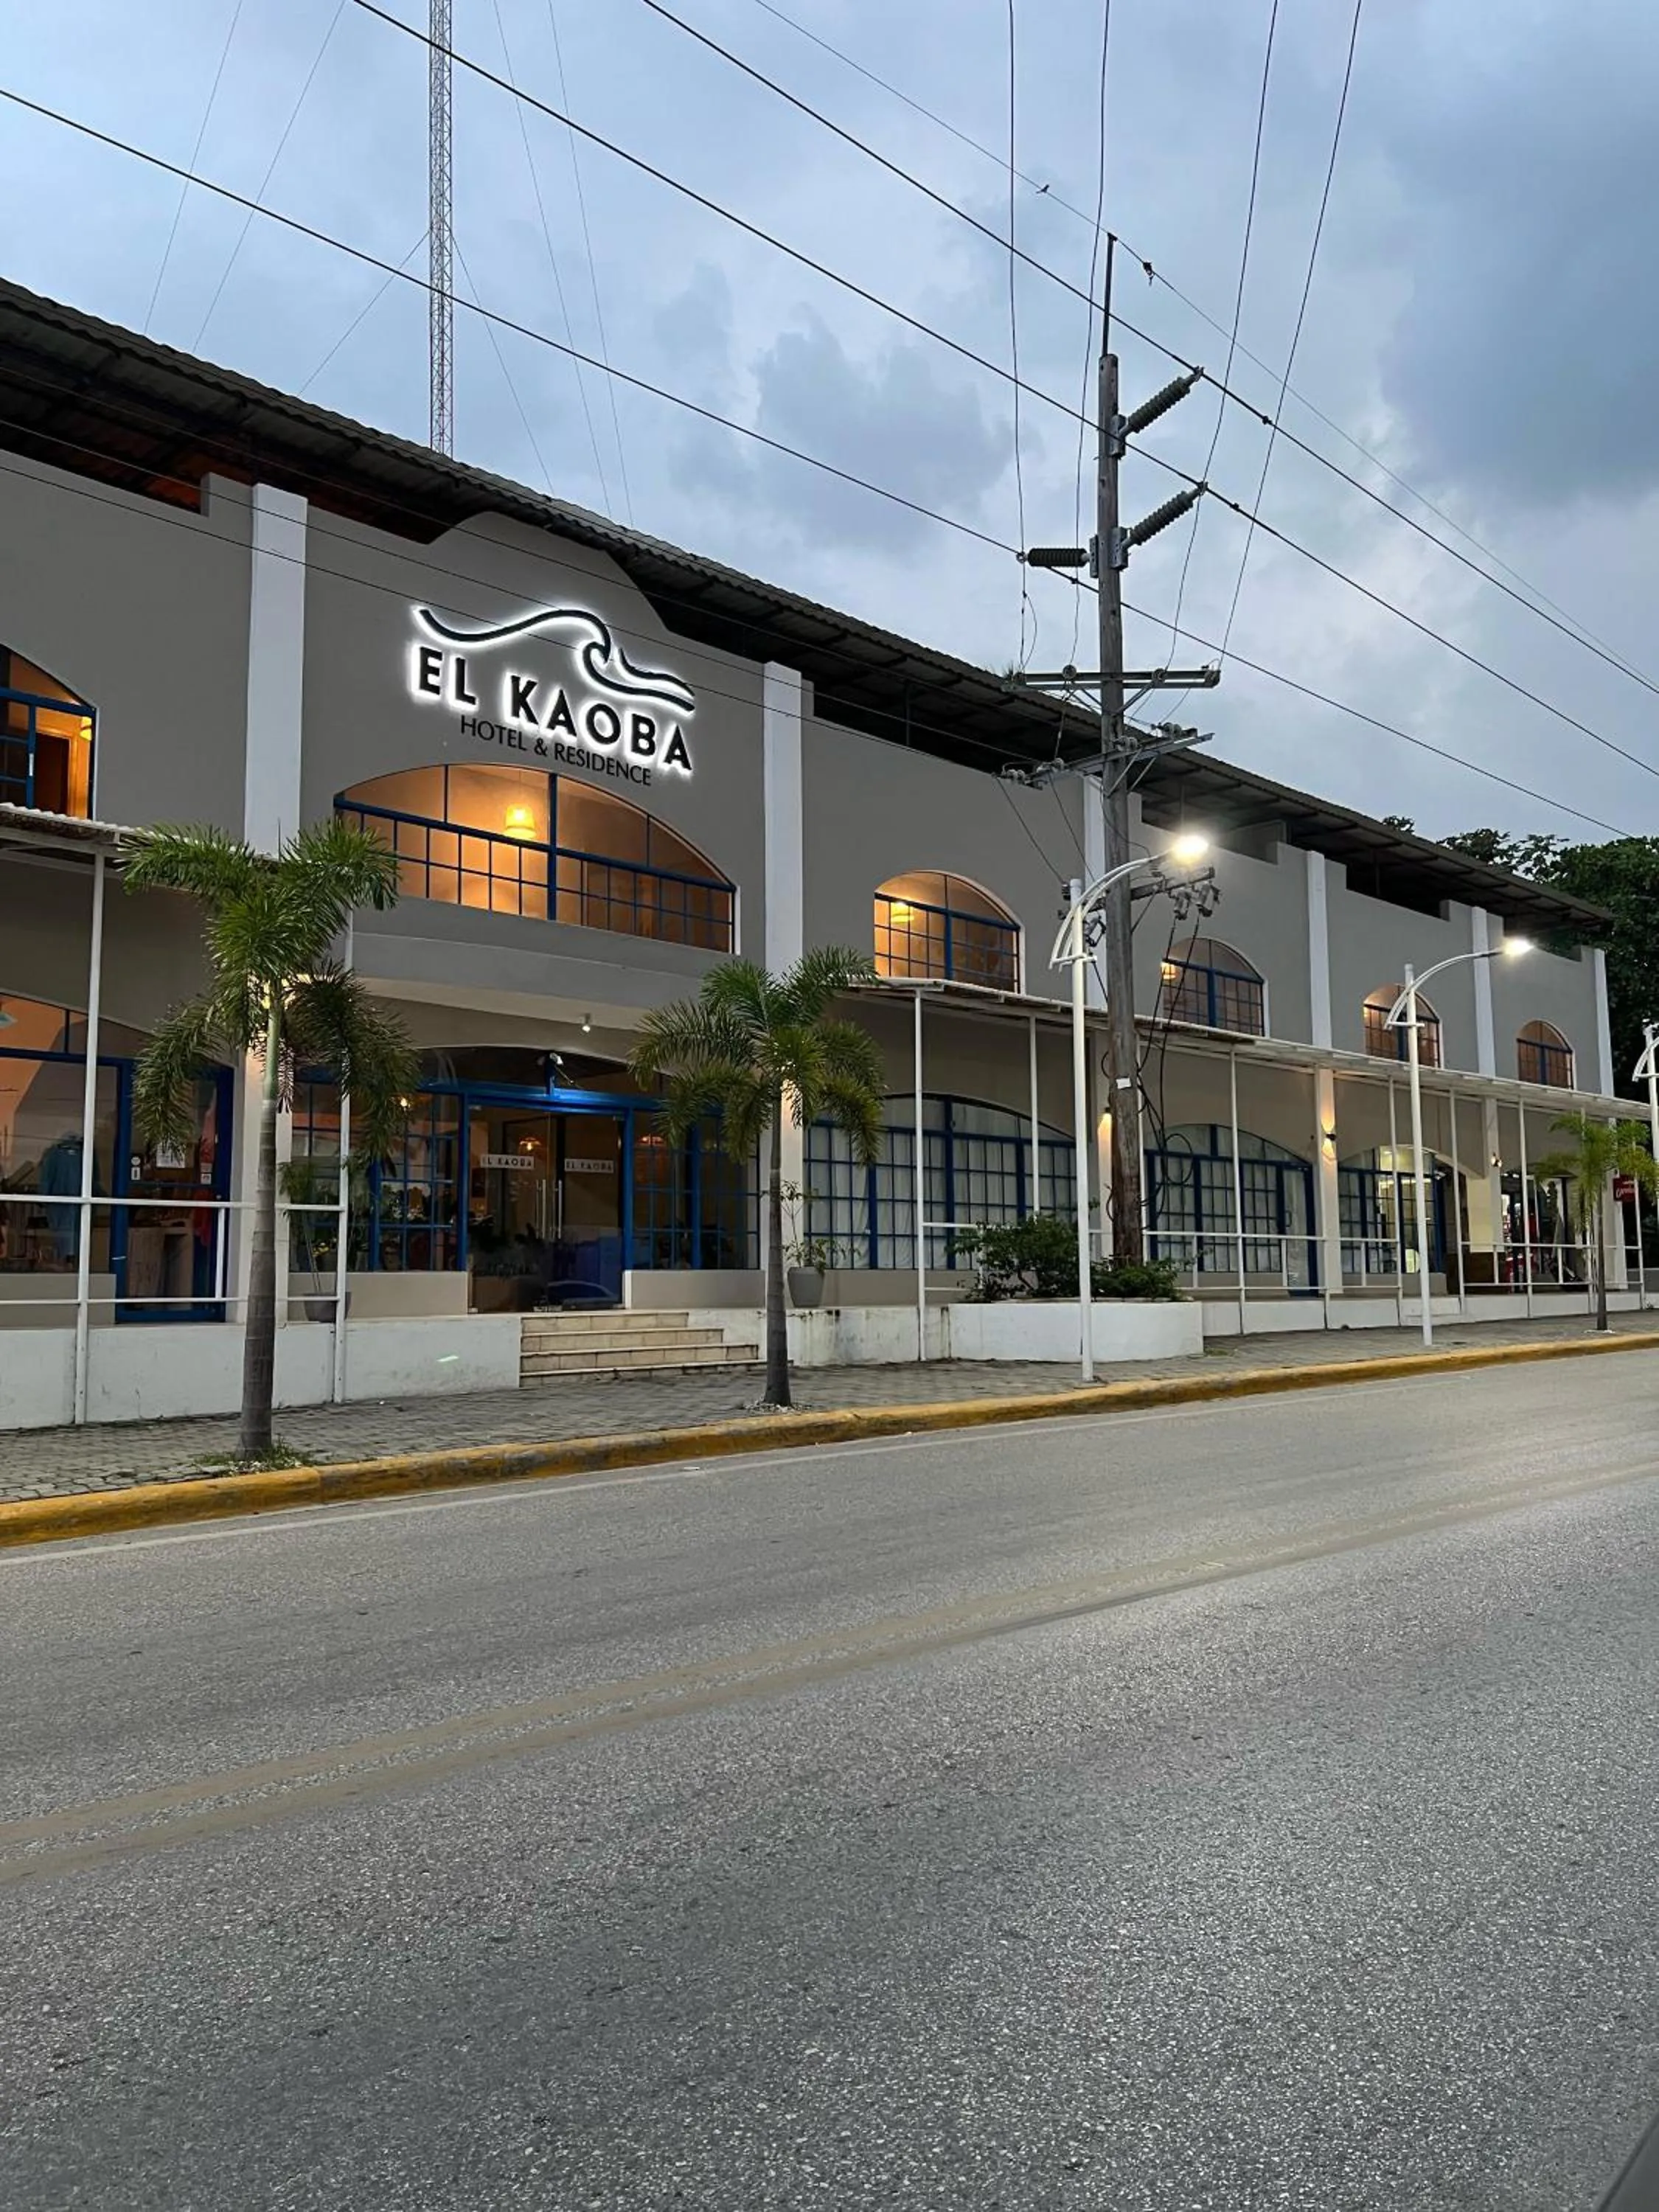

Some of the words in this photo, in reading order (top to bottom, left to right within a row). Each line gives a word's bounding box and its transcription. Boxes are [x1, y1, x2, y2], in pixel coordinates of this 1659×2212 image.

[420, 647, 476, 705] EL
[512, 676, 692, 770] KAOBA
[461, 715, 527, 751] HOTEL
[534, 738, 548, 757] &
[554, 743, 651, 786] RESIDENCE
